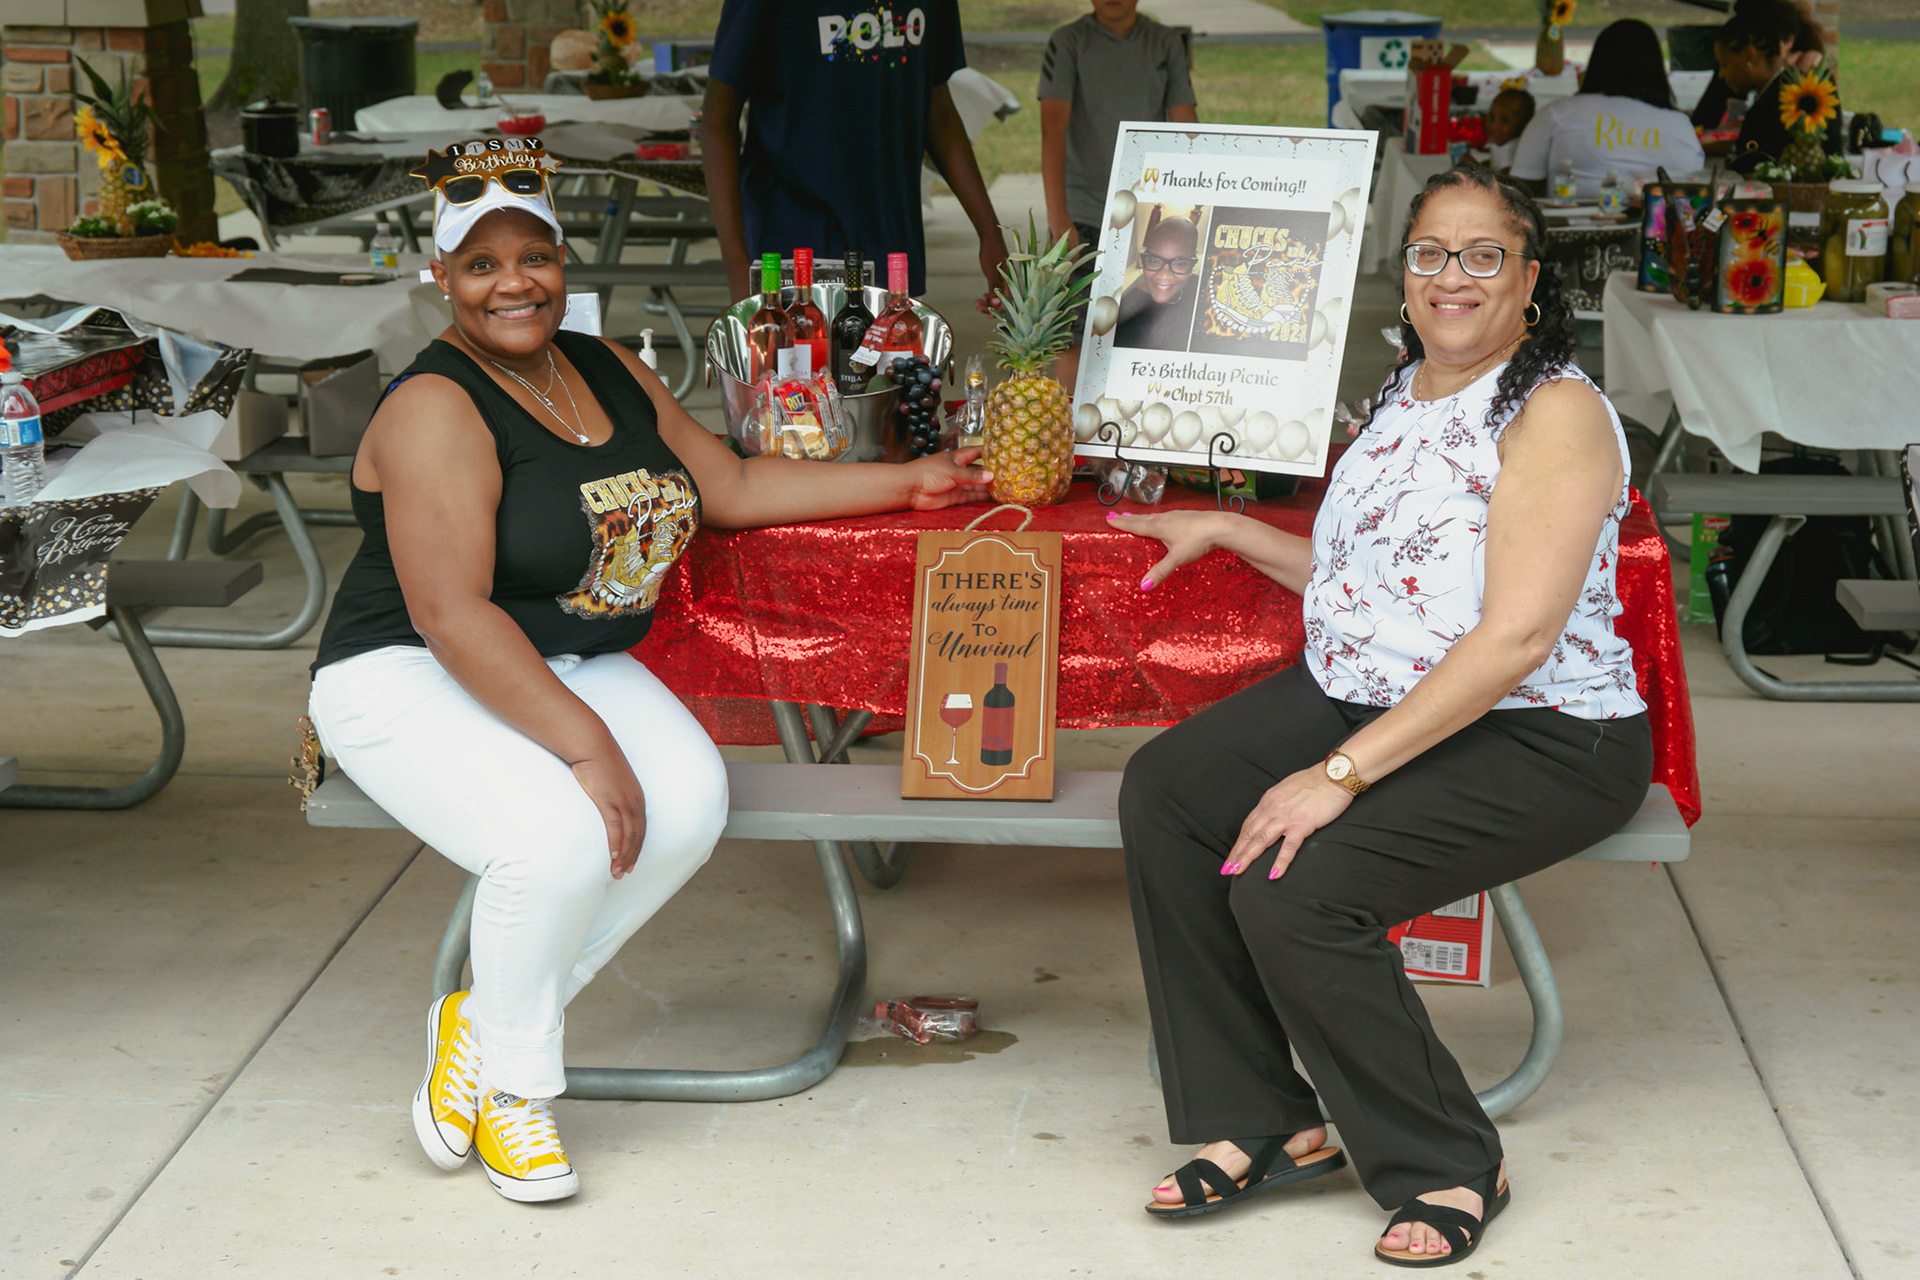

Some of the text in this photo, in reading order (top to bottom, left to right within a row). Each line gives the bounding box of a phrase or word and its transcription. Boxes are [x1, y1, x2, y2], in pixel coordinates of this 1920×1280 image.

[818, 8, 926, 54] POLO
[1594, 111, 1668, 151] Rica
[454, 152, 537, 172] Birthday
[1162, 170, 1307, 198] Thanks for Coming!!
[1214, 224, 1290, 252] CHUCKS
[1242, 243, 1324, 275] Pearls
[1270, 322, 1308, 344] 2021
[840, 374, 862, 383] STELLA
[1130, 361, 1280, 387] Fe's Birthday Picnic
[785, 392, 806, 412] RITZ
[1163, 386, 1234, 406] #Chpt 57th
[580, 468, 660, 515] CHUCKS
[627, 484, 698, 541] Pearls
[36, 535, 124, 580] Birthday
[936, 572, 1043, 590] THERE'S
[930, 592, 1043, 622] always time
[927, 631, 1043, 662] Unwind
